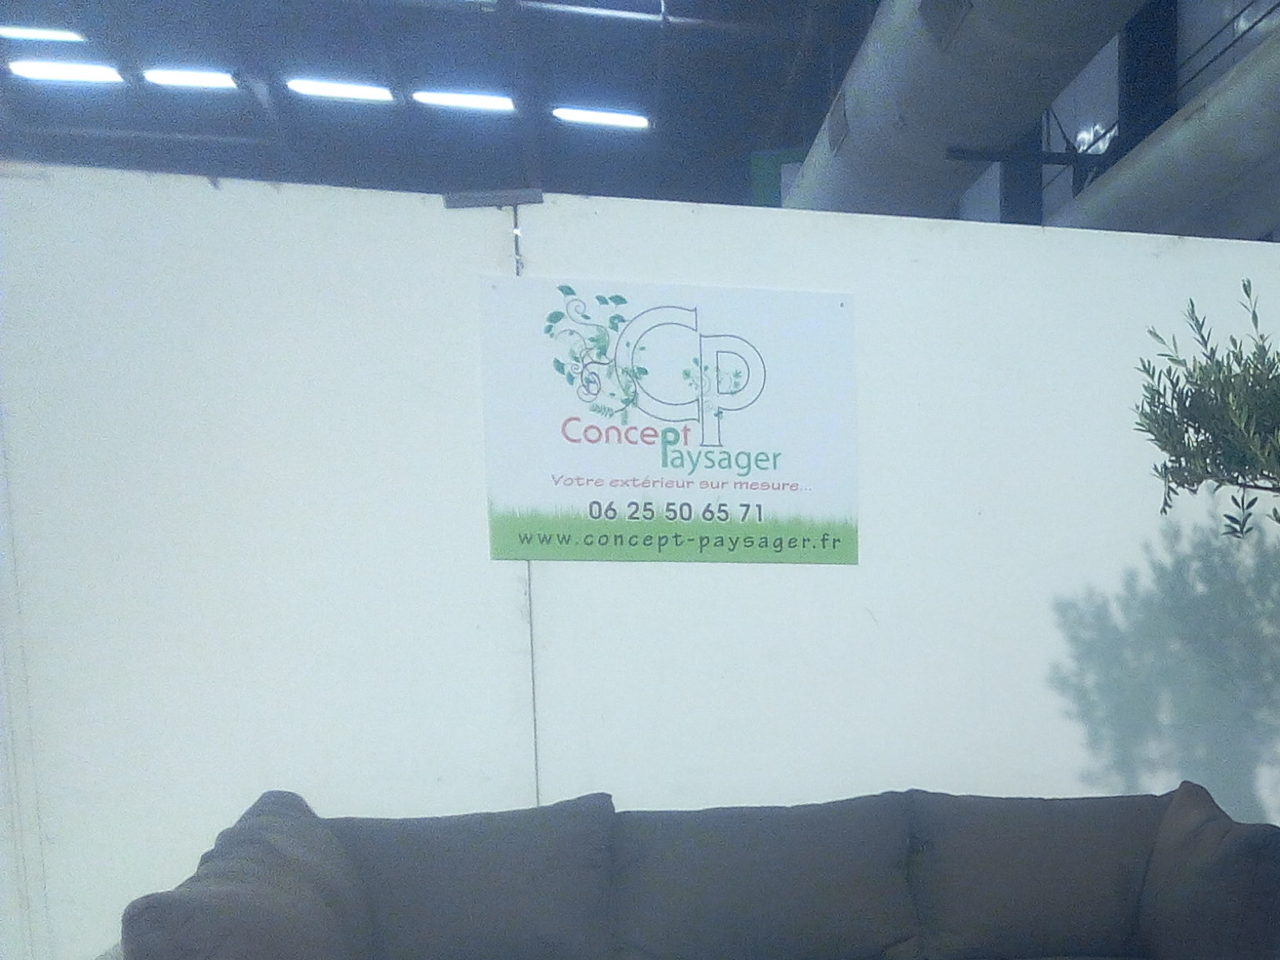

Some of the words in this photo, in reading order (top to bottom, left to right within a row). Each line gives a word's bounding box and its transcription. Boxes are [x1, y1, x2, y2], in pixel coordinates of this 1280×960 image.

[560, 416, 692, 468] Concept
[660, 427, 783, 477] Paysager
[551, 473, 605, 488] Votre
[609, 475, 694, 490] extérieur
[699, 478, 729, 490] sur
[588, 500, 618, 521] 06
[626, 501, 655, 521] 25
[664, 501, 693, 522] 50
[701, 502, 730, 522] 65
[739, 503, 764, 523] 71
[517, 529, 842, 554] www.concept-paysager.fr
